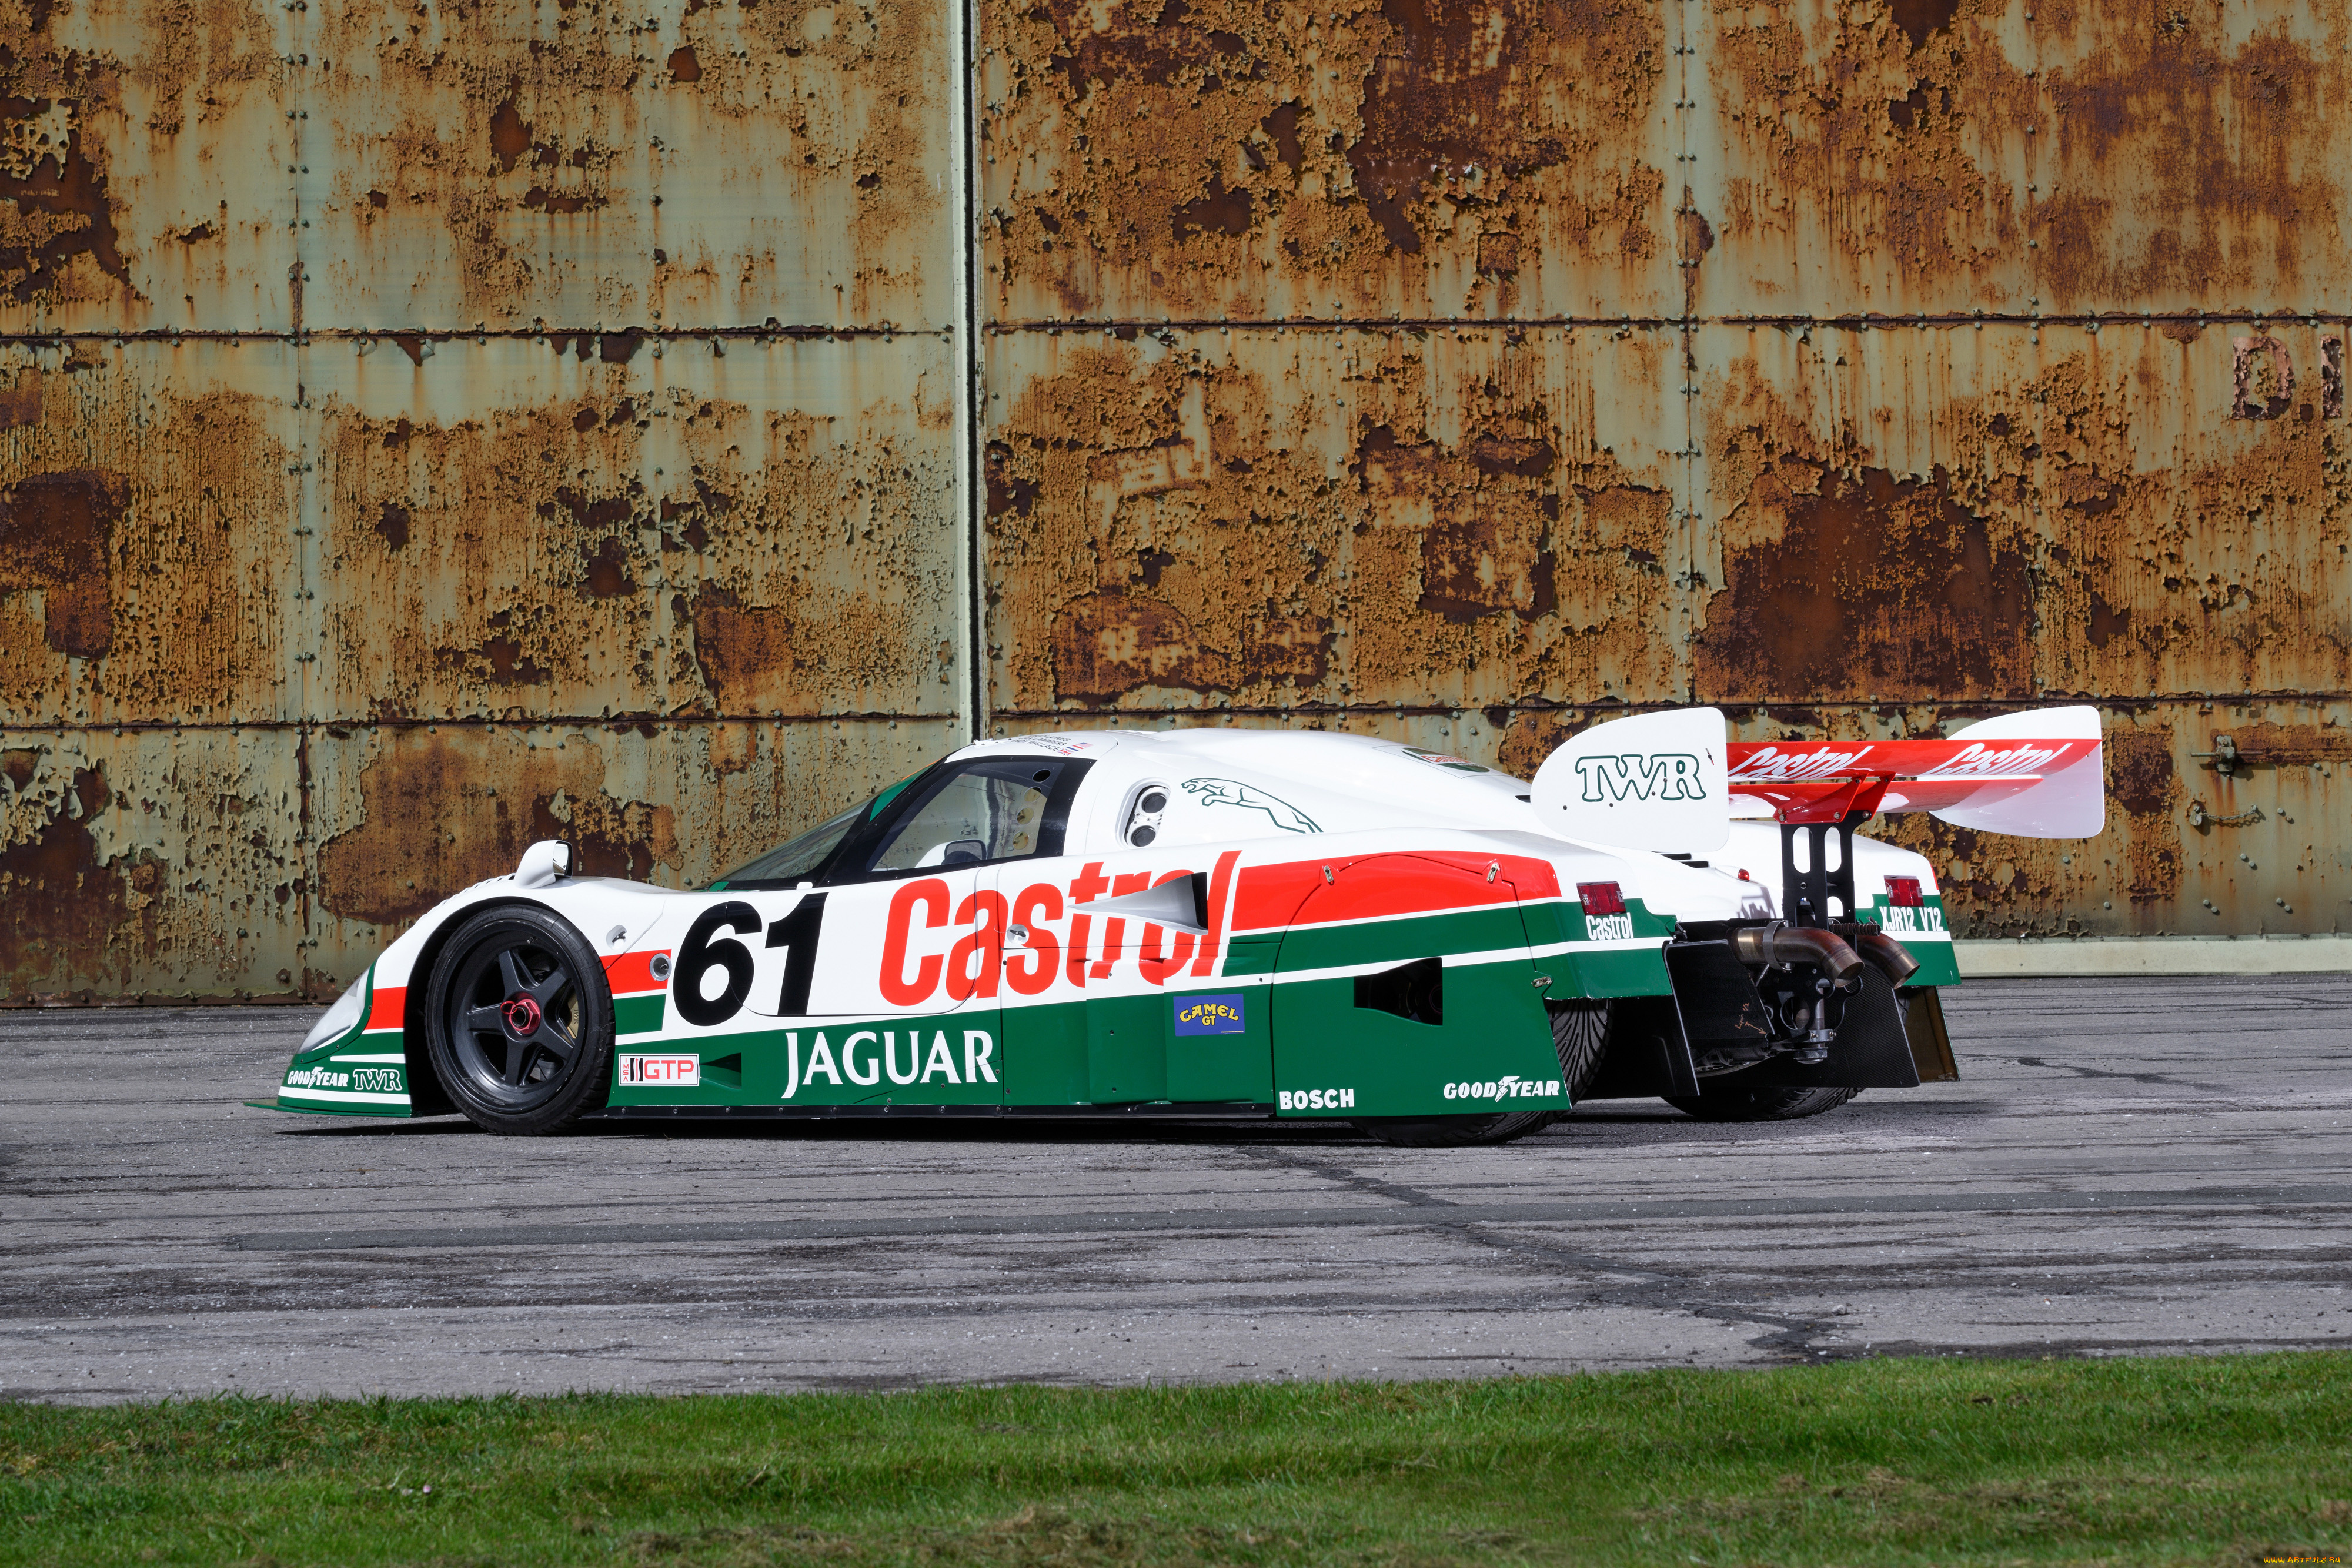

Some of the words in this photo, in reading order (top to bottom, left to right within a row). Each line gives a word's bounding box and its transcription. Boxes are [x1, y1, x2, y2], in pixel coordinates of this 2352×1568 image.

[1728, 745, 1875, 780] Castrol
[1922, 743, 2074, 775] Castrol
[1575, 753, 1707, 803] TWR
[879, 850, 1242, 1007] Castrol
[1585, 912, 1633, 940] Castrol
[1879, 906, 1917, 931] XJR12
[1919, 907, 1944, 931] V12
[673, 892, 830, 1027] 61
[1179, 1003, 1240, 1022] CAMEL
[1202, 1015, 1217, 1026] GT
[288, 1066, 349, 1089] GOODYEAR
[644, 1060, 694, 1079] GTP
[780, 1030, 998, 1099] JAGUAR
[353, 1068, 403, 1091] TWR
[1444, 1076, 1560, 1102] GOODYEAR
[1279, 1088, 1354, 1110] BOSCH
